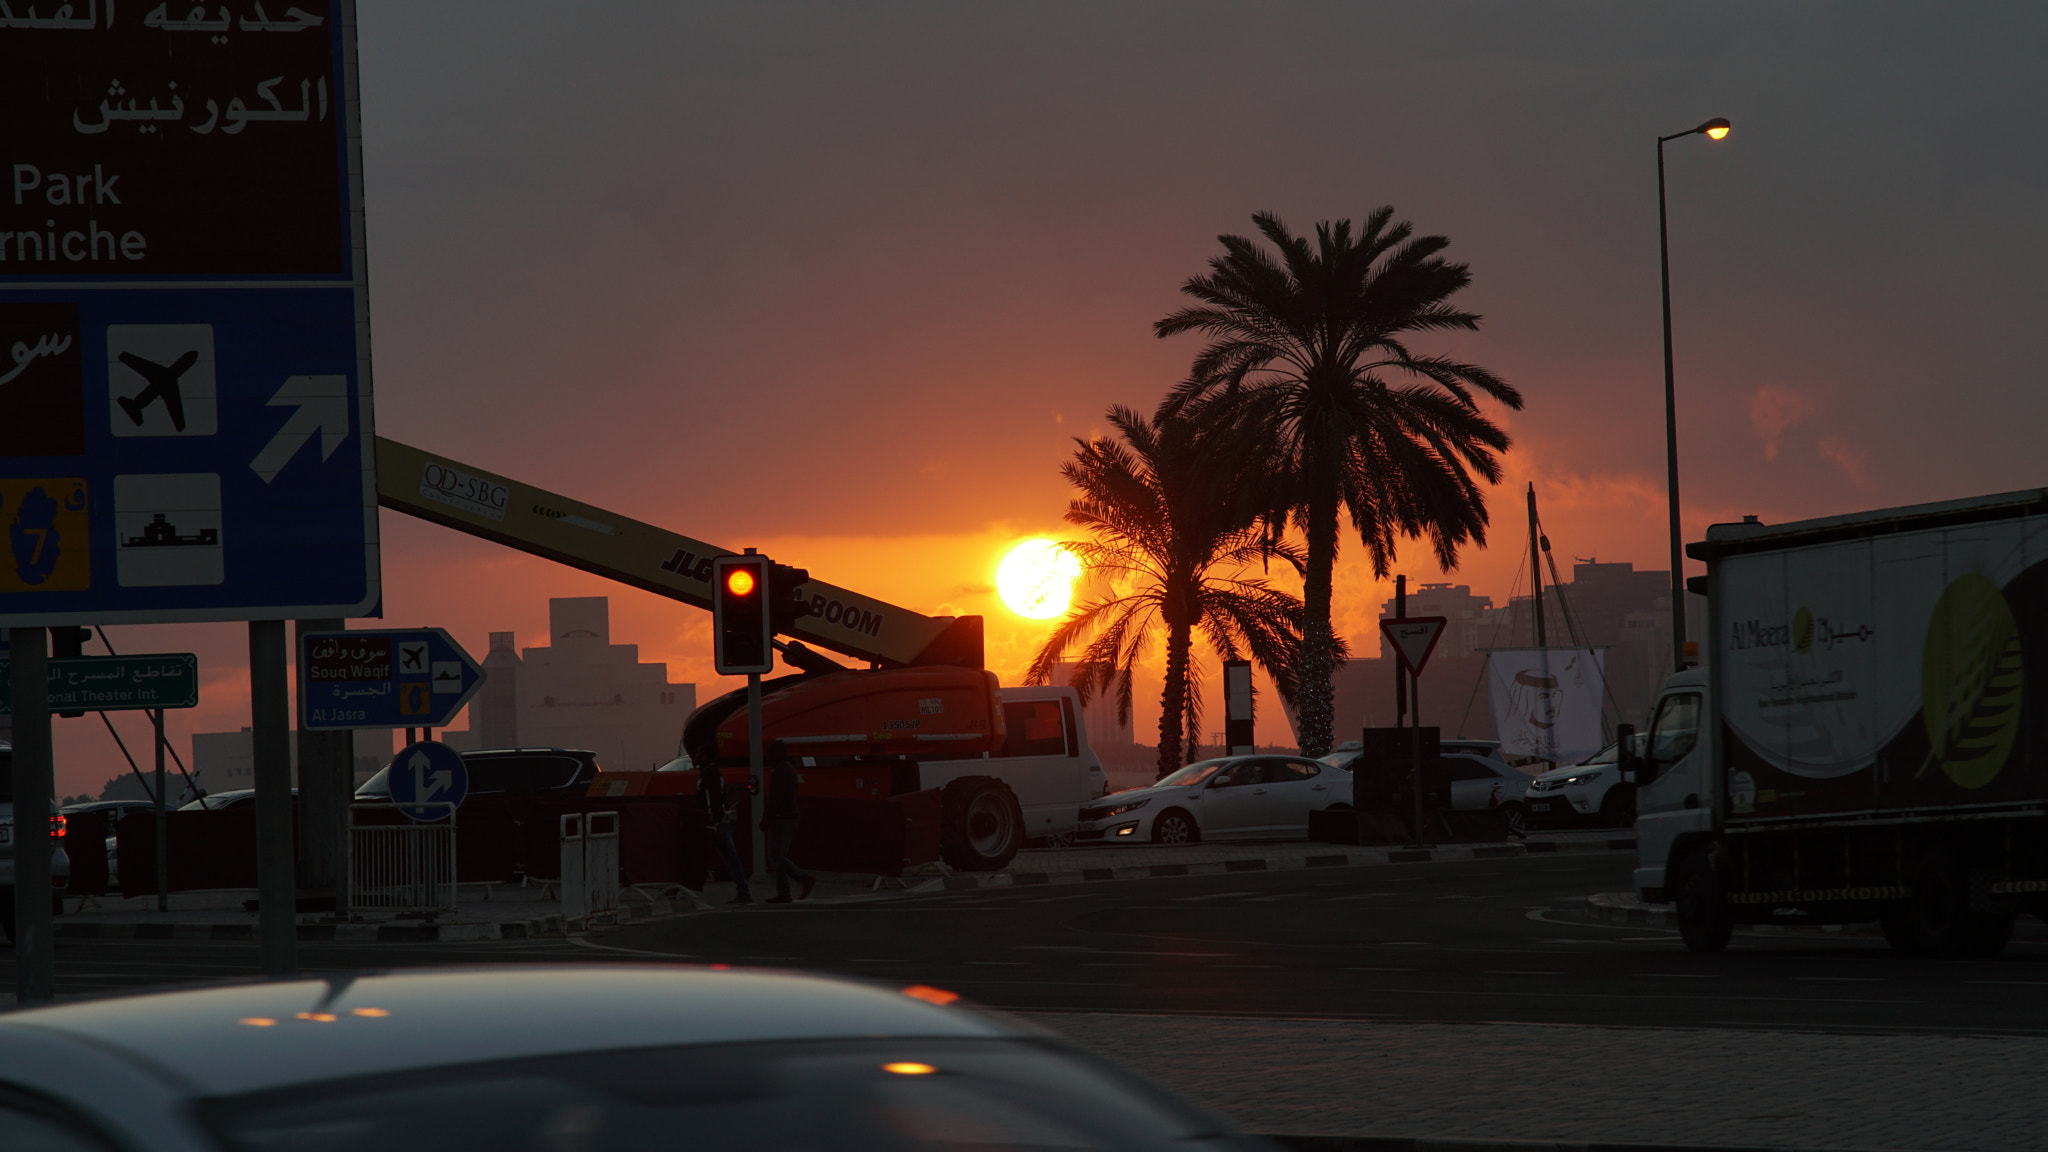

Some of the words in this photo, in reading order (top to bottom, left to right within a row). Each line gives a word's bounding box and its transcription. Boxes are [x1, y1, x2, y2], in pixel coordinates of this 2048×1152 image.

[72, 74, 328, 135] الكورنيش
[13, 163, 122, 206] Park
[0, 219, 147, 262] rniche
[425, 464, 507, 507] QD-SBG
[23, 528, 48, 566] 7
[660, 549, 712, 584] JLG
[808, 593, 884, 637] BOOM
[1400, 625, 1428, 639] افسح
[350, 638, 387, 664] سوق
[67, 665, 125, 685] المسرح
[131, 664, 183, 683] تقاطع
[311, 665, 347, 680] Souq
[350, 664, 391, 679] Waqif
[47, 690, 78, 703] onal
[81, 688, 133, 702] Theater
[332, 681, 391, 700] الجسرة
[312, 708, 327, 721] Al
[330, 707, 366, 721] Jasra
